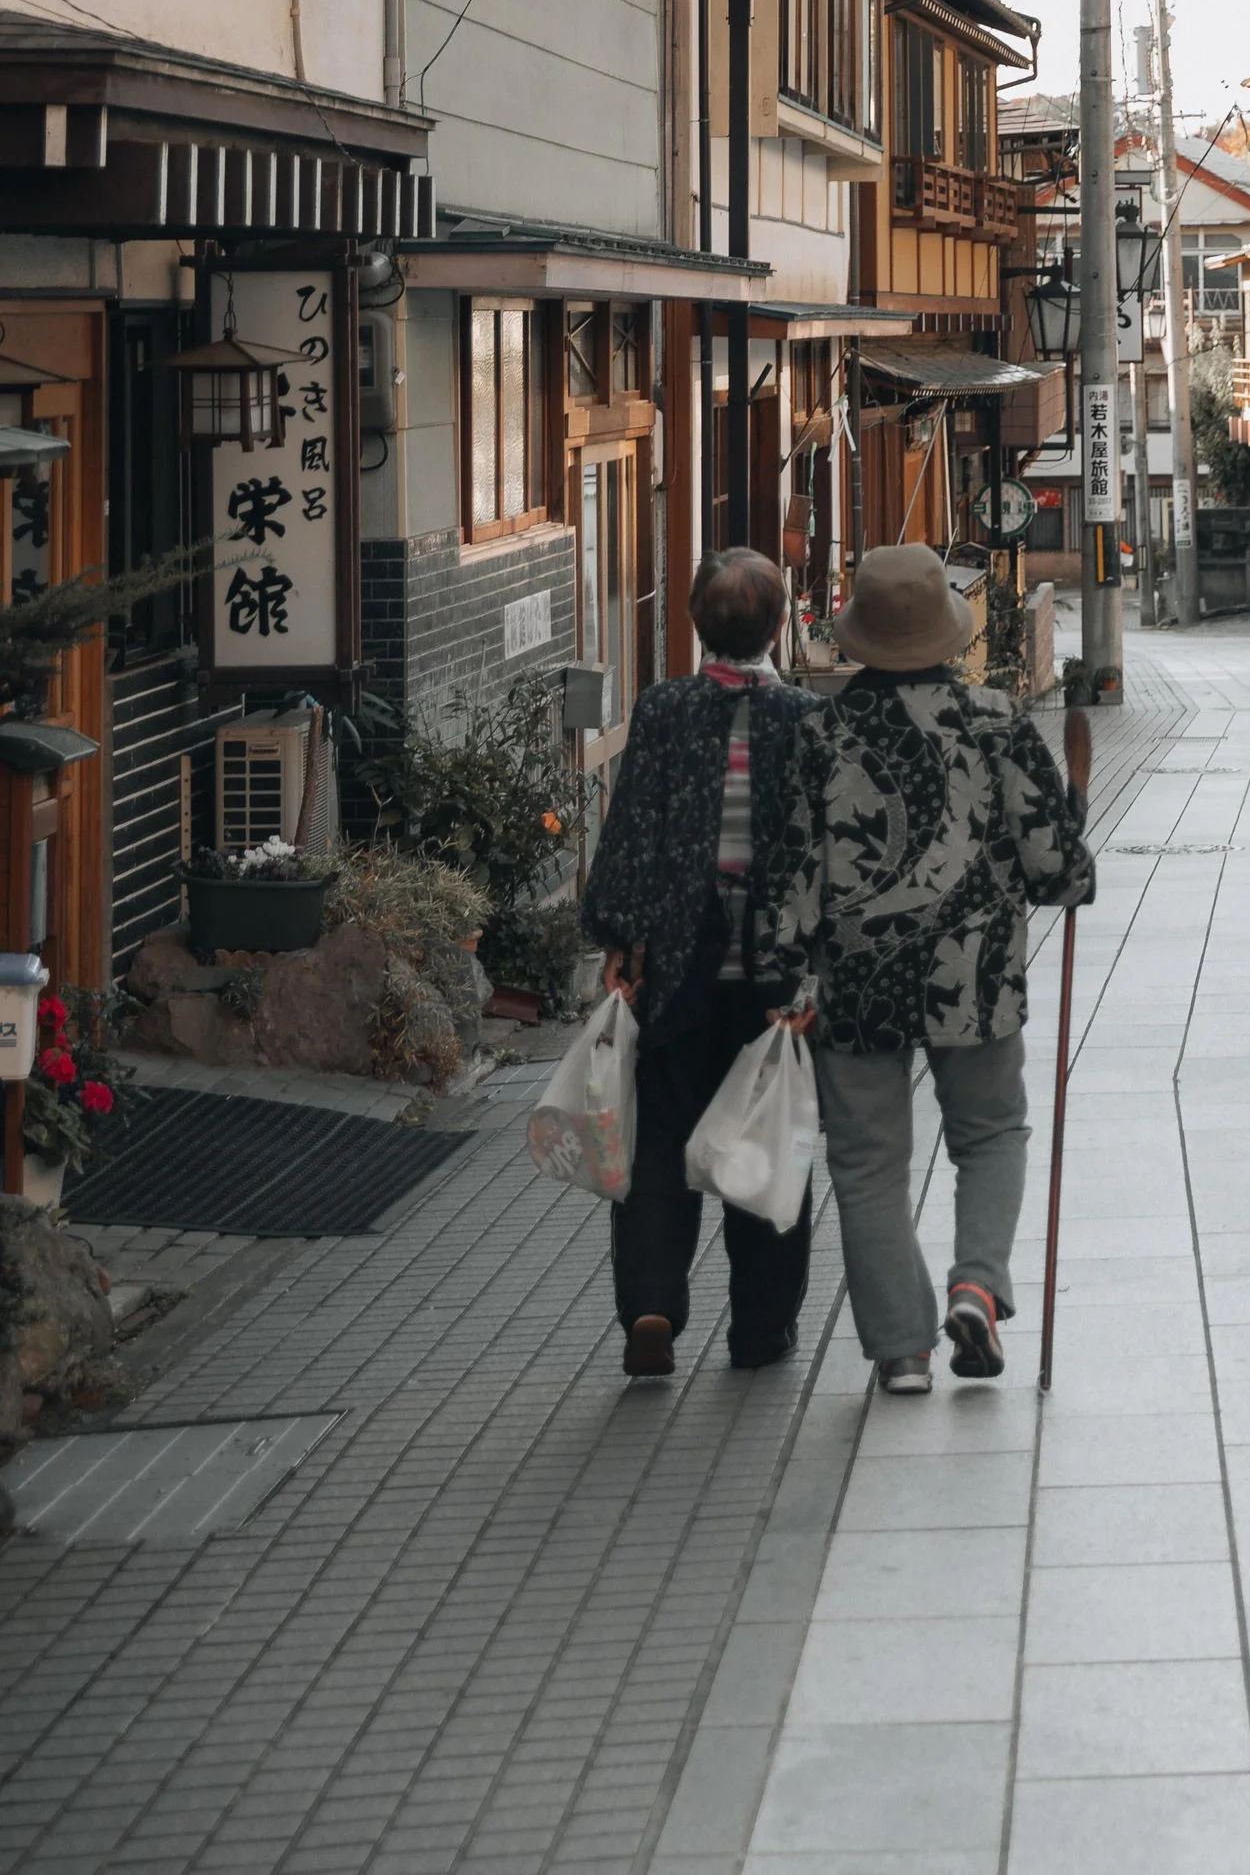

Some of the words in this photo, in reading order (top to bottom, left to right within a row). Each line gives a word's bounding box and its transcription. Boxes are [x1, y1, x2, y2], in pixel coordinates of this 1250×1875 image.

[225, 365, 297, 638] 栄館
[296, 285, 331, 522] ひのき風呂
[1090, 403, 1108, 496] 若木屋旅館
